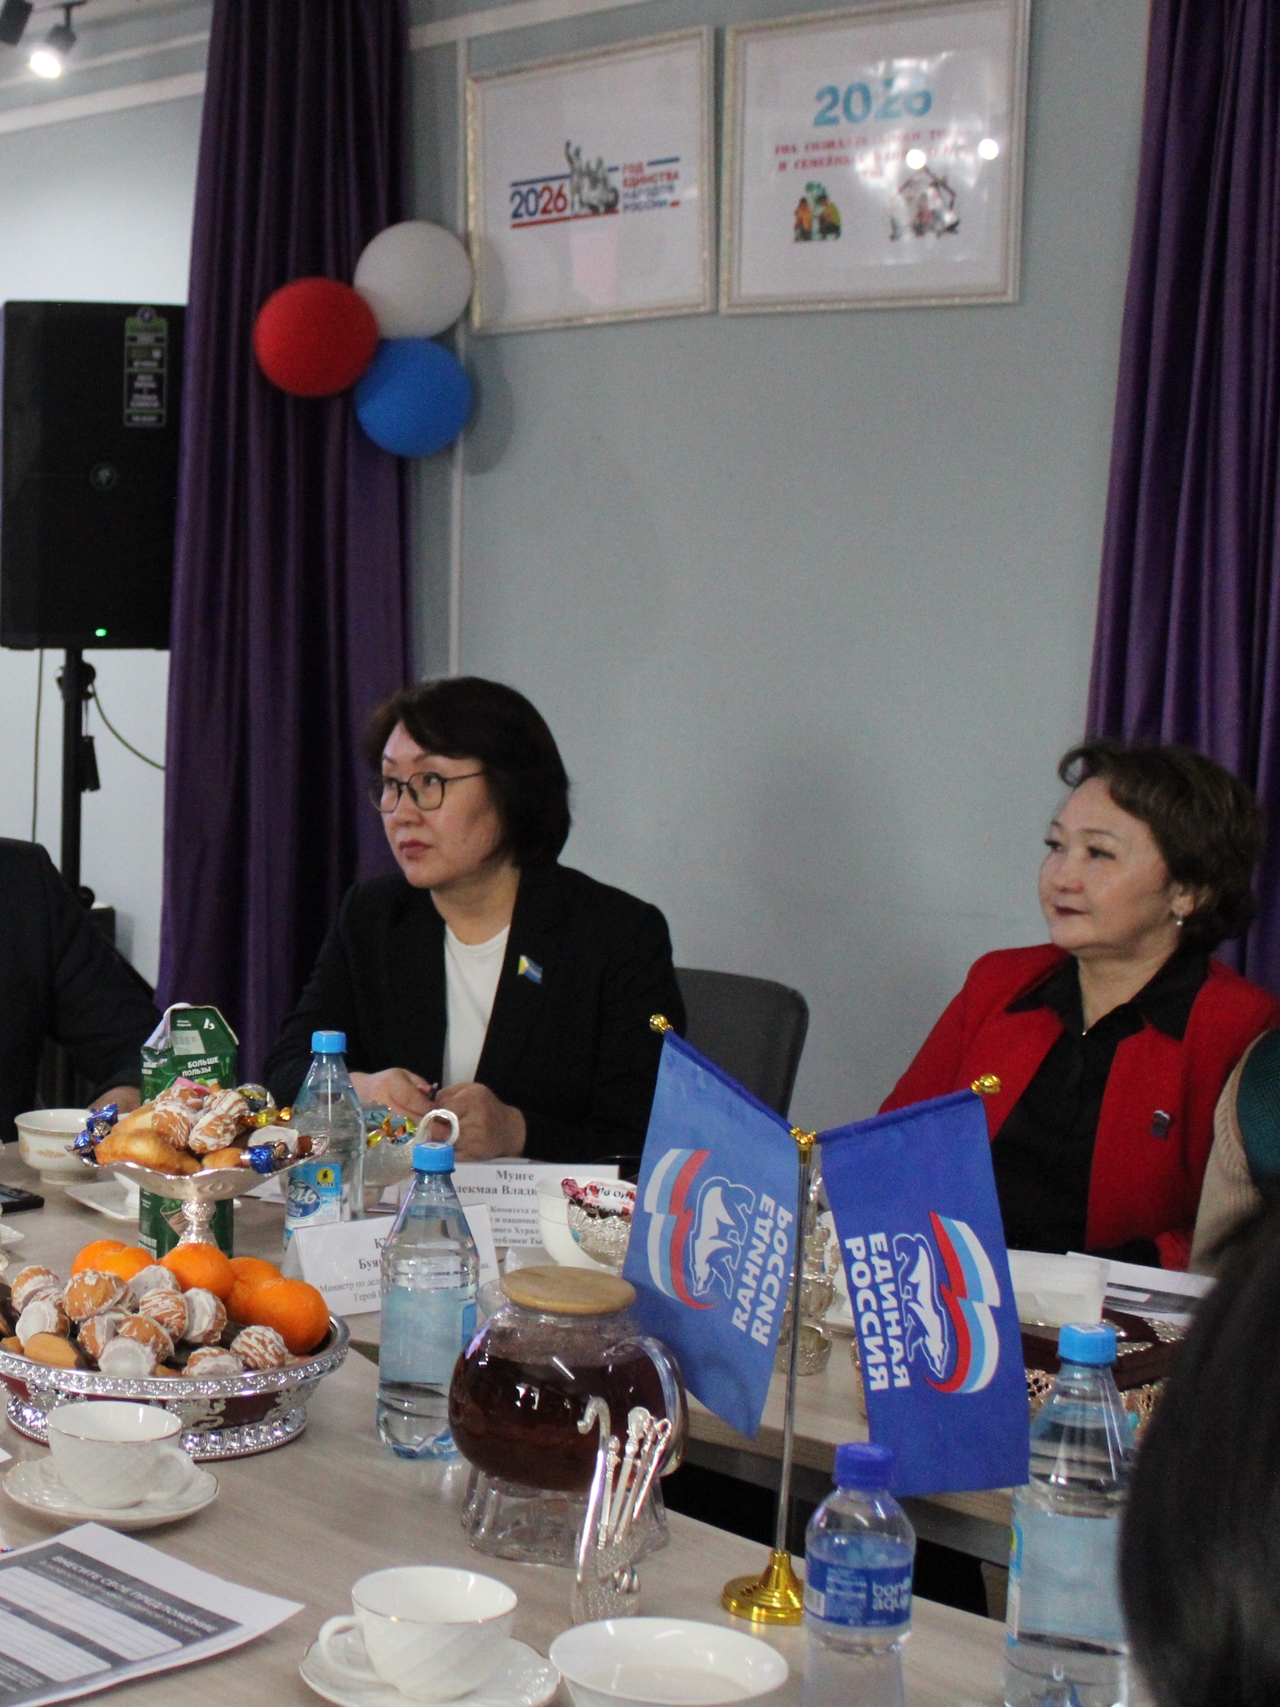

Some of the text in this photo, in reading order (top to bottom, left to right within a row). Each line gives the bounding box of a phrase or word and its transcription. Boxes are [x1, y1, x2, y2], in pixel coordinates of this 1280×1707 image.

[510, 184, 569, 219] 2026
[181, 1066, 212, 1077] ПОЛЬЗЫ
[187, 1056, 219, 1069] БОЛЬШЕ
[496, 1170, 535, 1183] Мунге
[844, 1236, 889, 1390] РОССИЯ
[868, 1232, 911, 1388] ЕДИНАЯ
